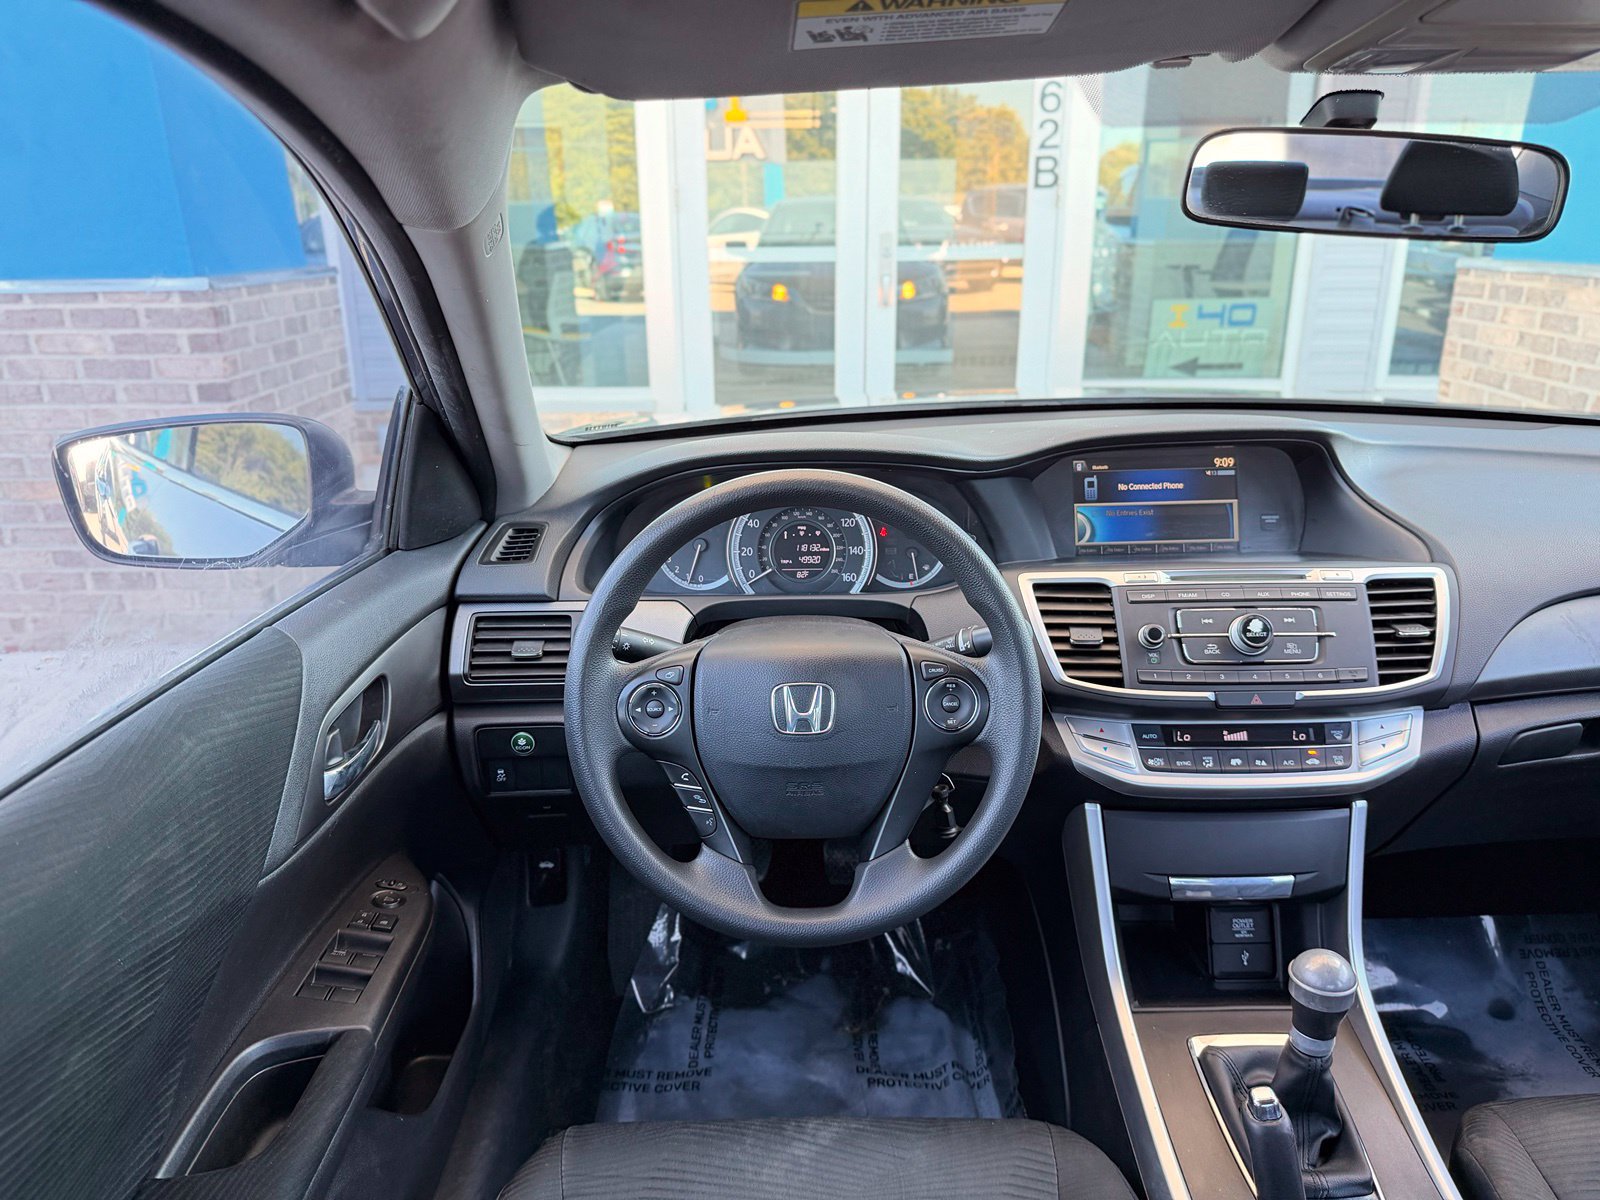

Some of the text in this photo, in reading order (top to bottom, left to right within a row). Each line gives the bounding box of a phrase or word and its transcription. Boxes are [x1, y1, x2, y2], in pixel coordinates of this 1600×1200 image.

[880, 0, 1017, 9] WARNI
[896, 10, 965, 19] ADVANCED
[1197, 303, 1258, 327] 40
[1213, 457, 1235, 468] 9:09
[1118, 482, 1184, 491] No Connected Phone
[747, 519, 760, 528] 40
[840, 518, 856, 527] 120
[741, 547, 753, 556] 20
[848, 546, 864, 555] 140
[749, 569, 755, 579] 0
[841, 572, 857, 582] 160
[1535, 961, 1562, 1012] DEALER
[1556, 1013, 1585, 1045] MUST
[1524, 970, 1600, 1079] PROTECTIVE COVER
[687, 1028, 702, 1070] DEALER
[615, 1066, 713, 1081] MUST REMOVE
[913, 1062, 949, 1081] MUST
[654, 1080, 701, 1094] COVER
[866, 1077, 950, 1091] PROTECTIVE
